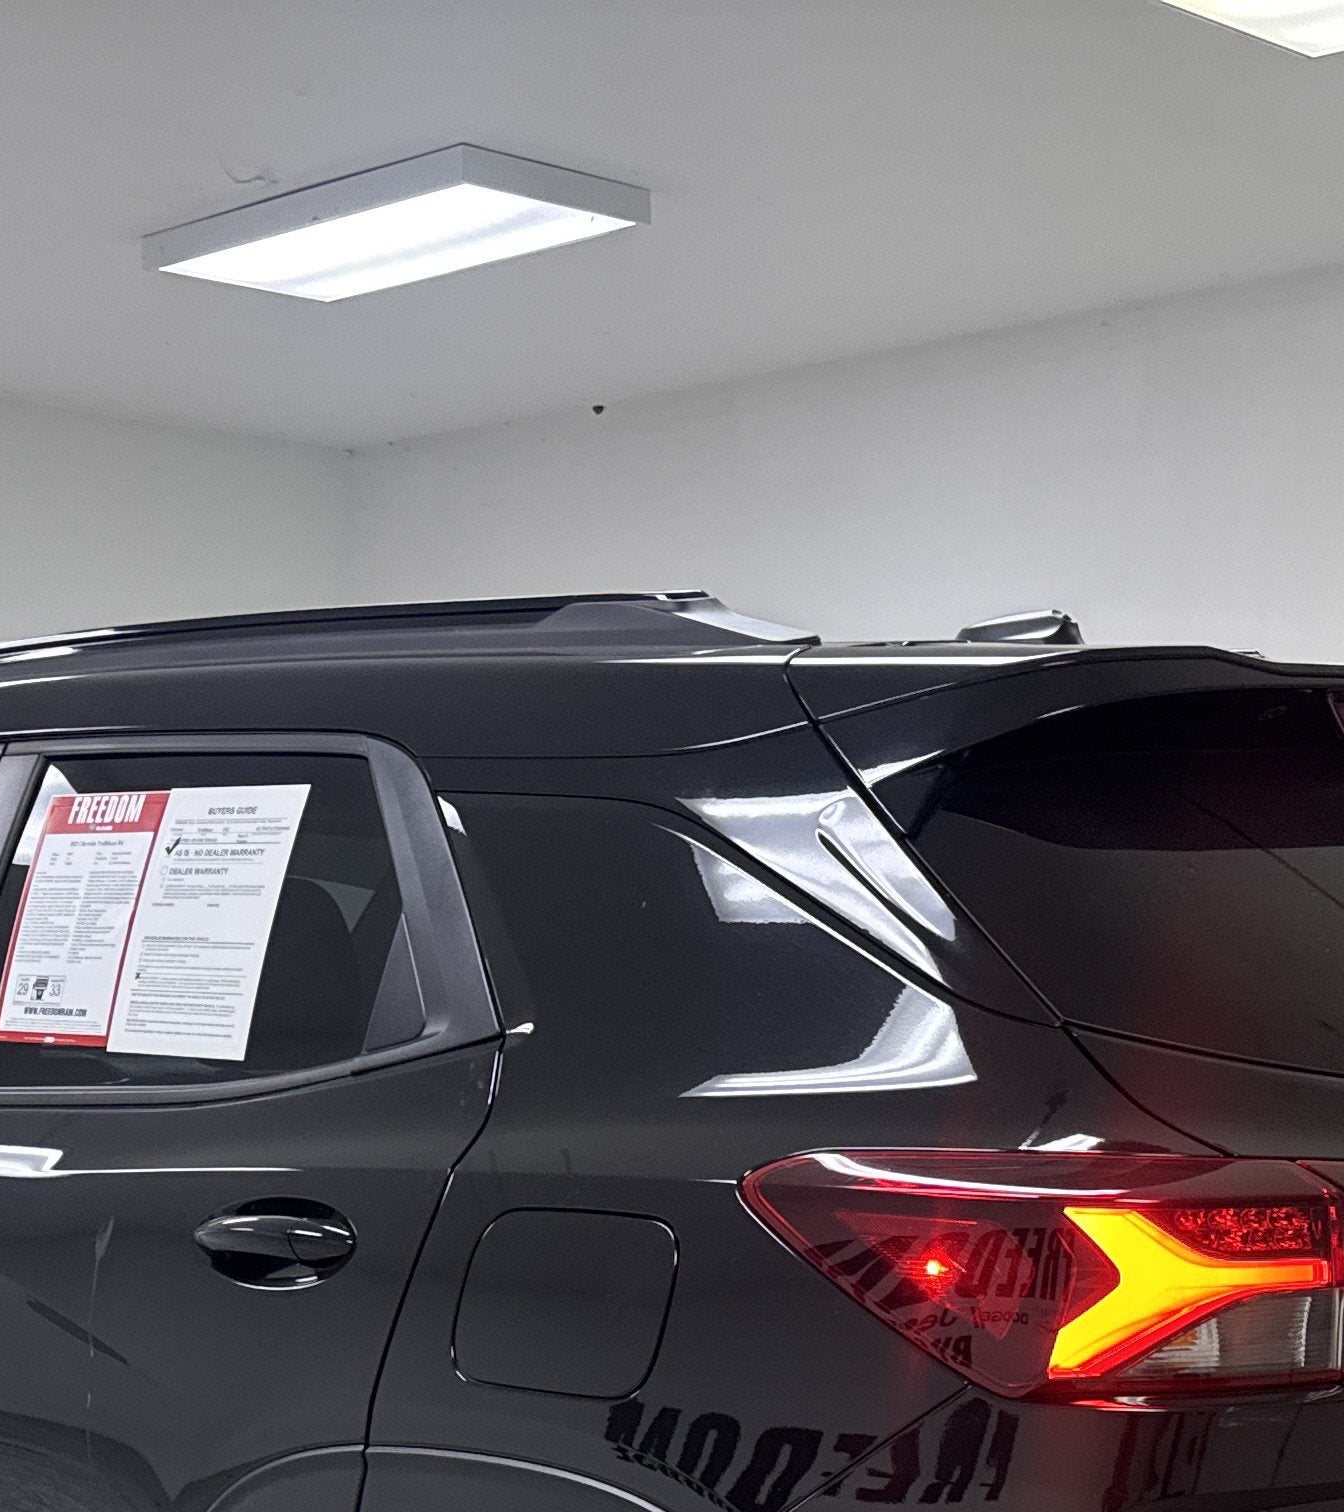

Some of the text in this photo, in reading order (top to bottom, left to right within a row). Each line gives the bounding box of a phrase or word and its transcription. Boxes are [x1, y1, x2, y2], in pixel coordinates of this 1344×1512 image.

[68, 794, 146, 825] FREEDOM
[204, 849, 229, 857] DEALER
[229, 849, 266, 857] WARRANTY
[169, 867, 229, 875] DEALER WARRANTY
[17, 982, 62, 996] 29 33
